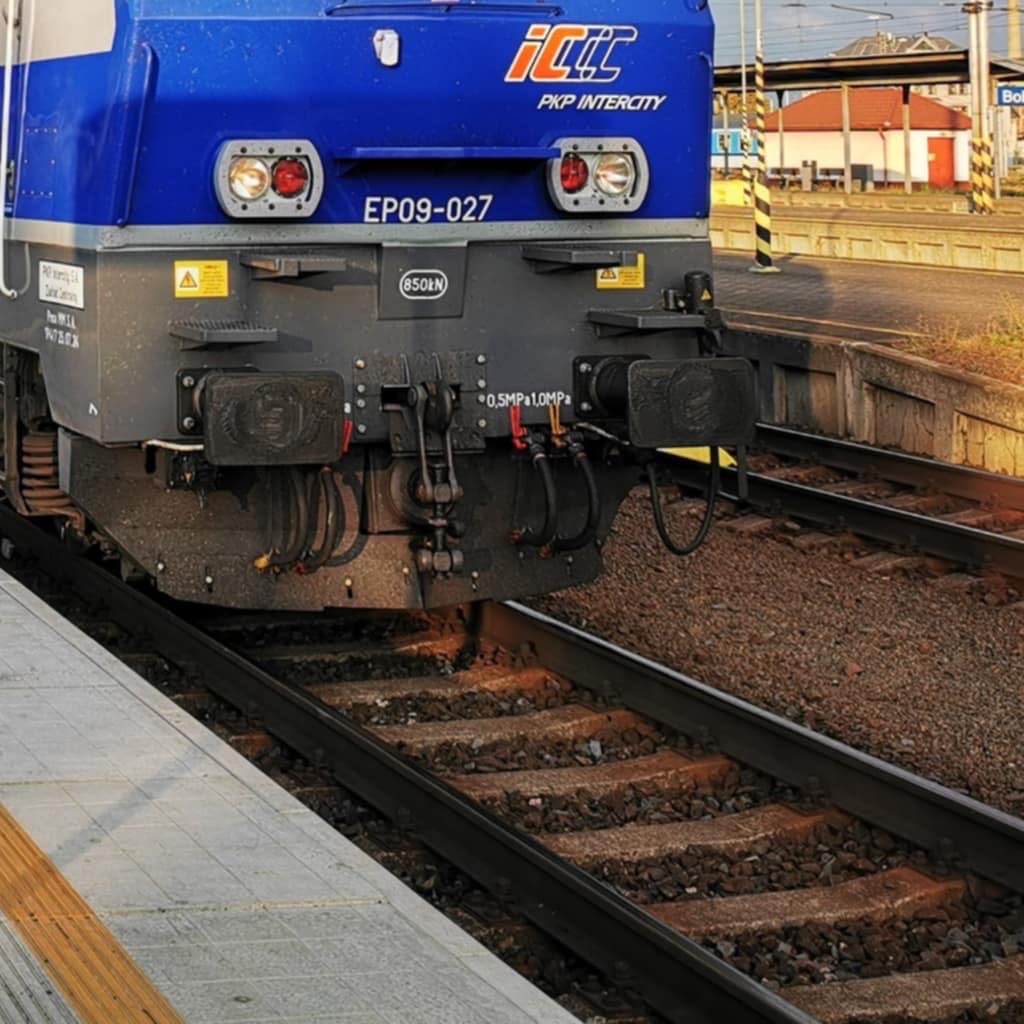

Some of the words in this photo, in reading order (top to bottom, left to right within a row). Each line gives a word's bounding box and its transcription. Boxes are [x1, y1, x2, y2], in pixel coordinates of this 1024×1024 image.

[537, 93, 577, 111] PKP
[576, 93, 668, 111] INTERCITY
[363, 194, 494, 223] EP09-027
[402, 277, 445, 293] 850kN
[486, 392, 531, 409] 0,5MPa
